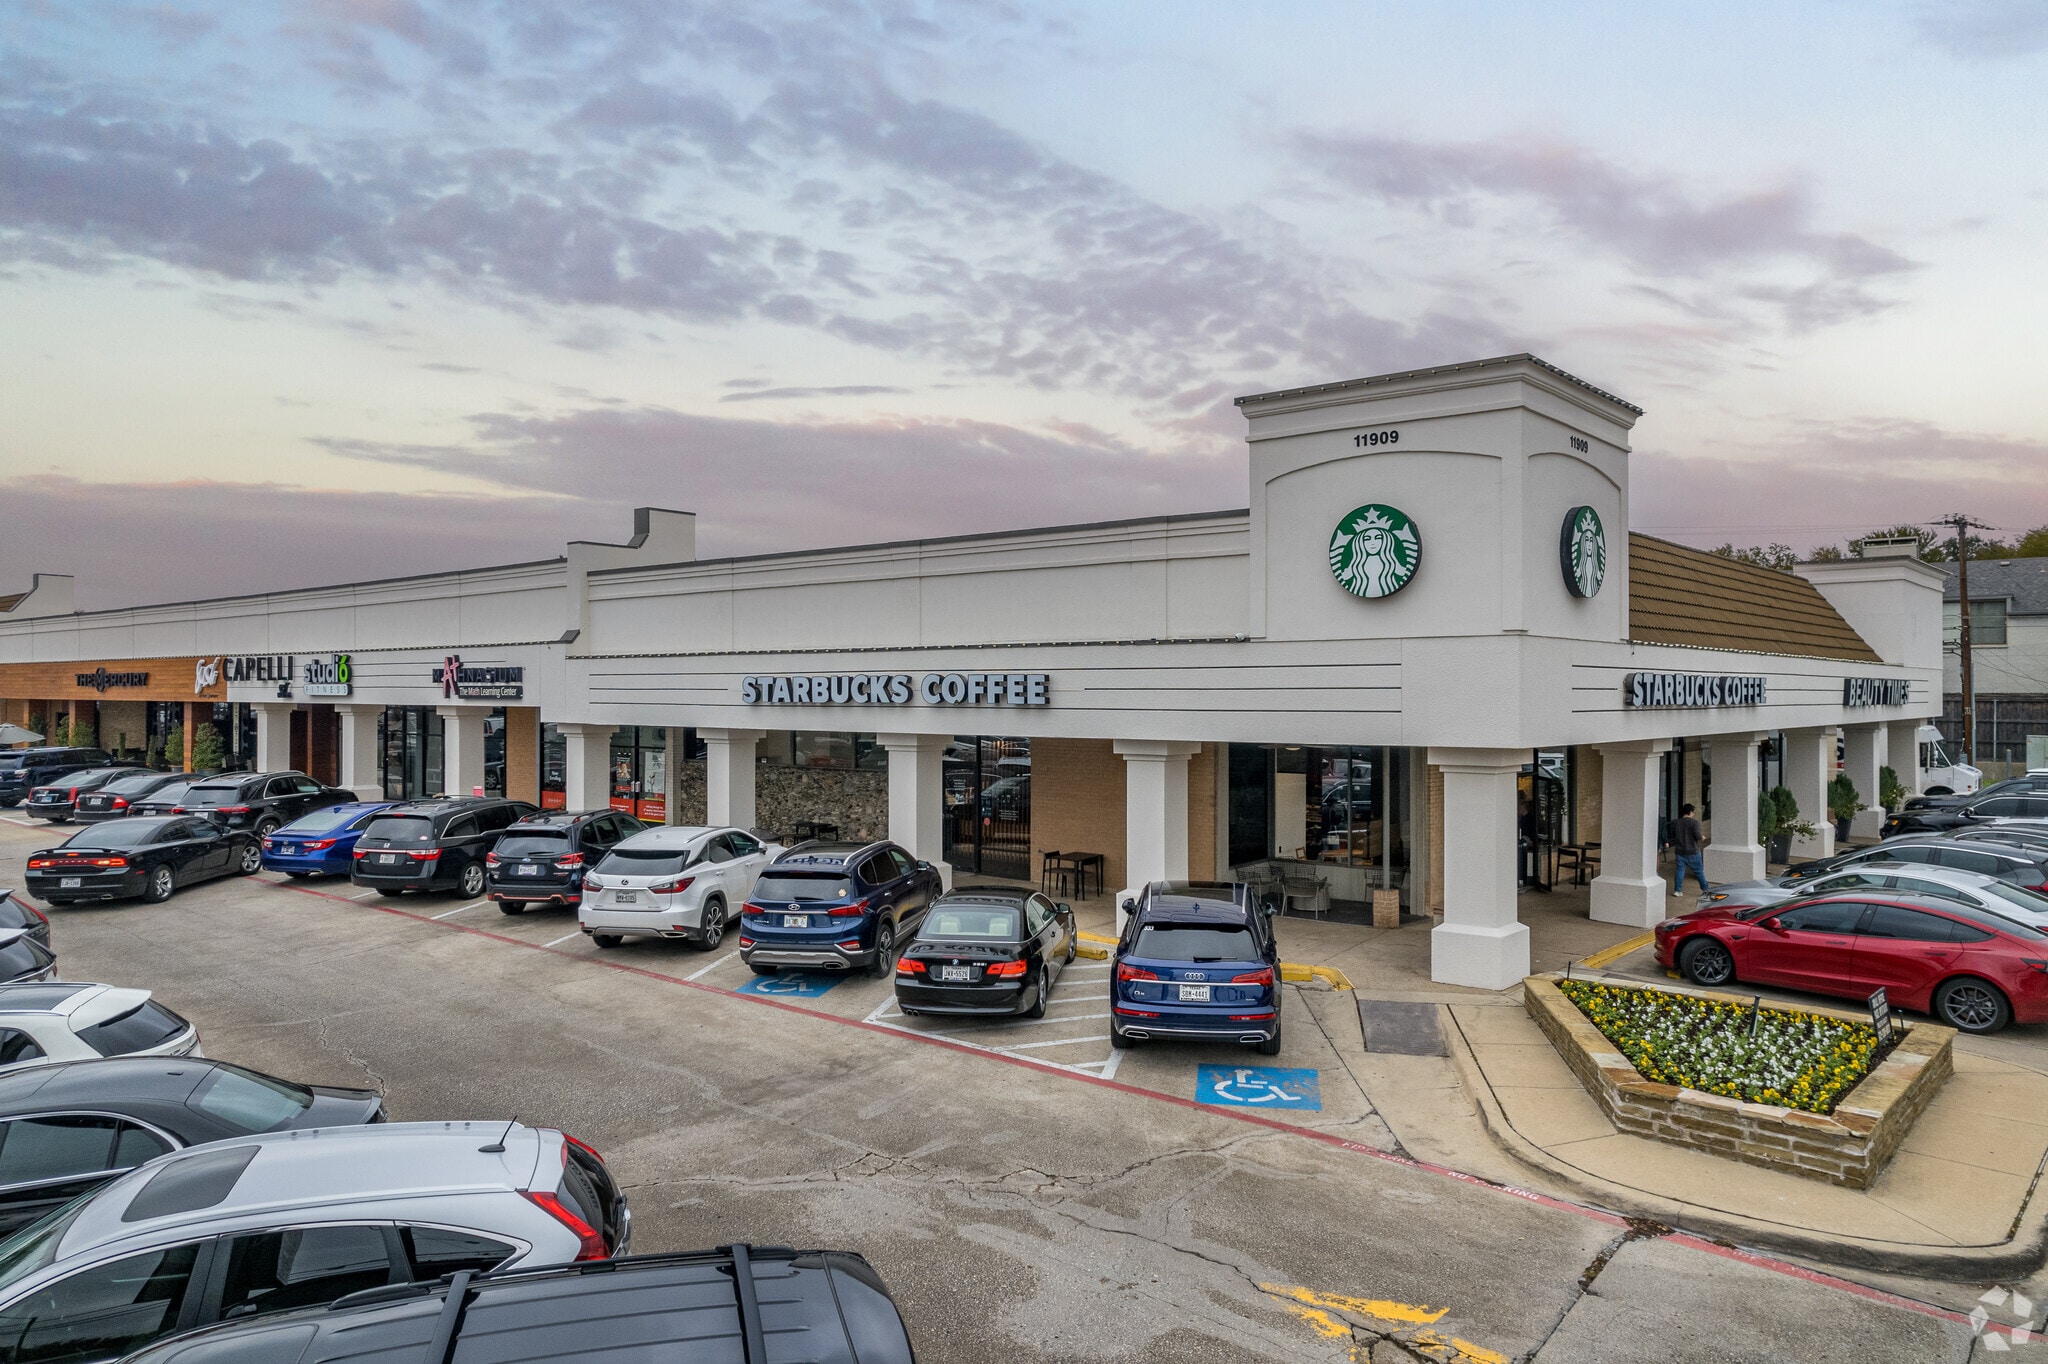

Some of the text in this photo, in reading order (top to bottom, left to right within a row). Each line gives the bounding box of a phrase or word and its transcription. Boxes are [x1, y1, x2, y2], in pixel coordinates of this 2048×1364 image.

[1353, 430, 1399, 447] 11909
[1570, 435, 1588, 454] 11909
[223, 655, 294, 681] CAPELLI
[76, 670, 149, 689] THE MERCURY
[742, 673, 1050, 705] STARBUCKS COFFEE
[305, 685, 347, 694] FITNESS
[459, 687, 517, 698] The Math Learning Center
[1631, 672, 1767, 707] STARBUCKS COFFEE
[1848, 679, 1911, 706] BEAUTY TIMES
[1447, 1171, 1469, 1180] NO
